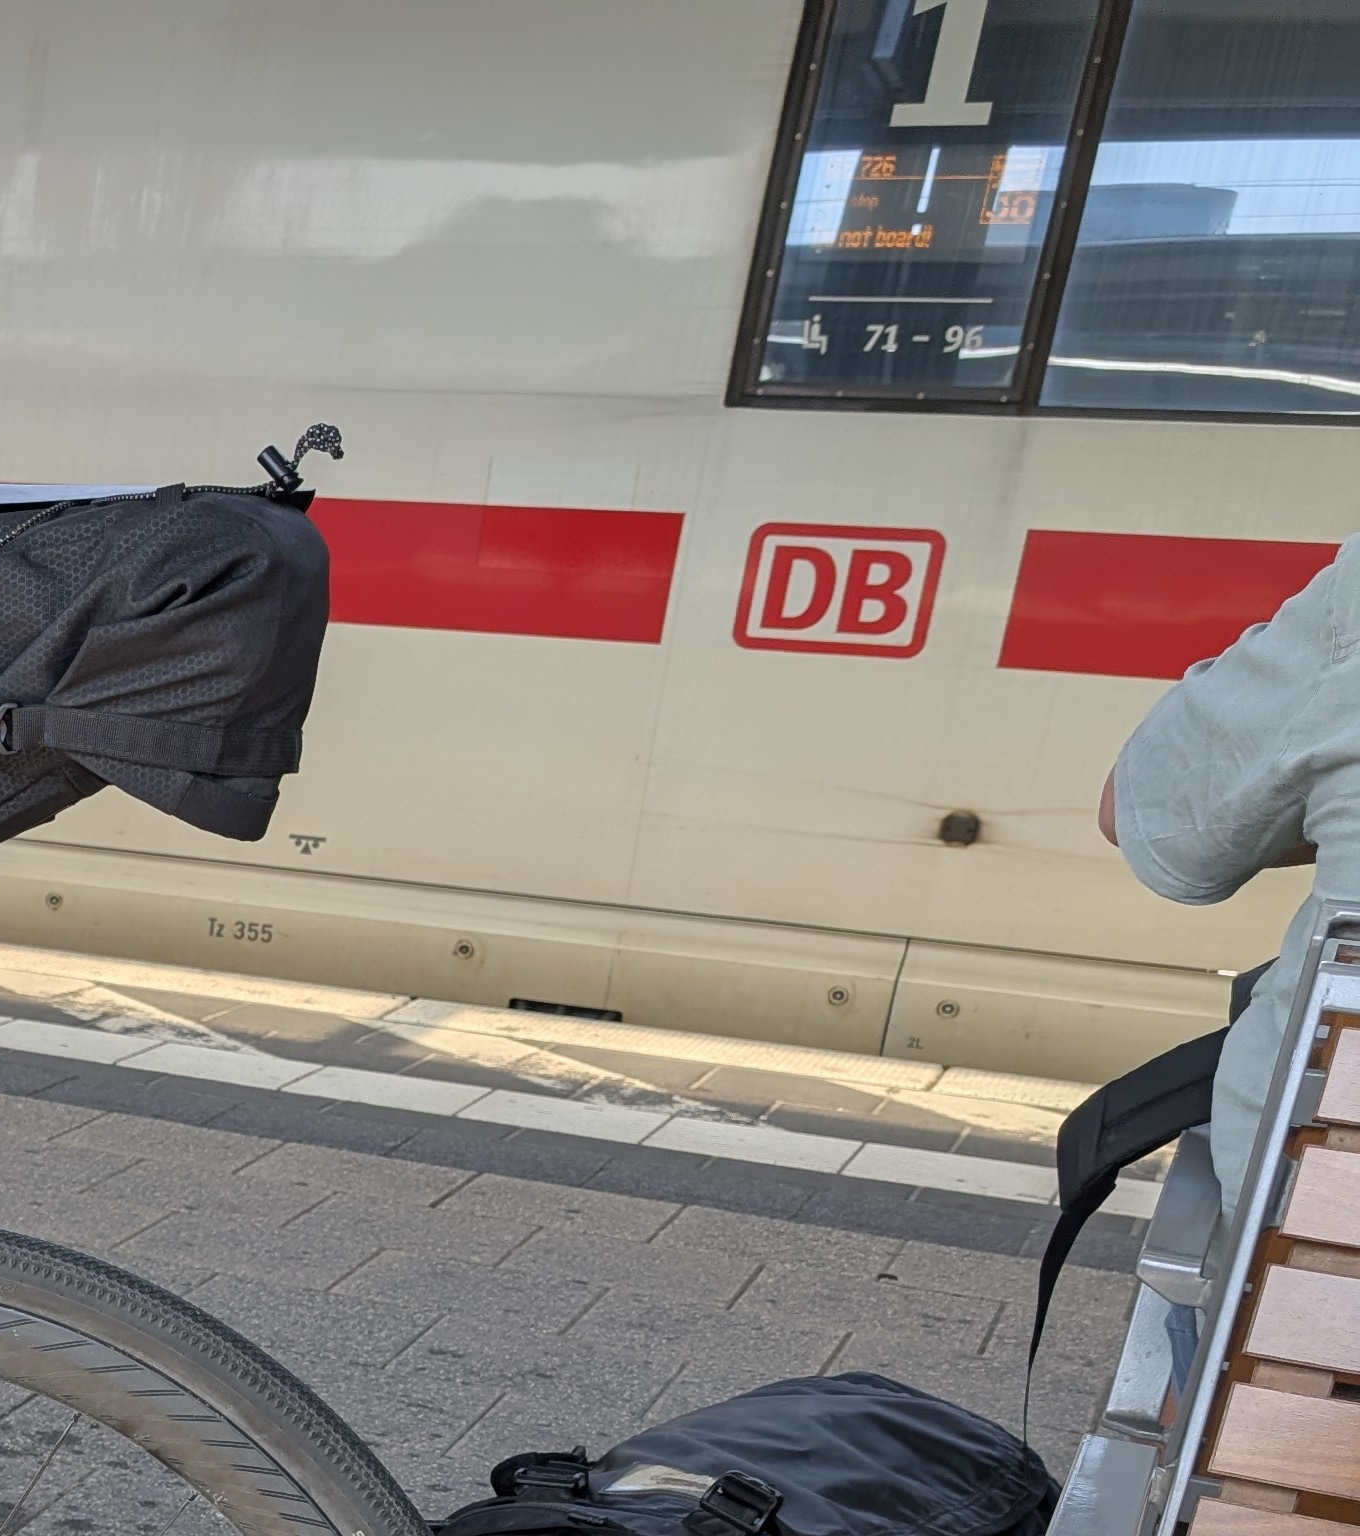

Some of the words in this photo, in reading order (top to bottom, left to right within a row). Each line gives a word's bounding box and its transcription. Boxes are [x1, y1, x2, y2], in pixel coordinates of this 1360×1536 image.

[889, 0, 993, 127] 1
[862, 324, 898, 352] 71
[944, 324, 984, 352] 96
[759, 545, 913, 635] DB
[208, 917, 226, 938] Tz
[233, 920, 274, 944] 355
